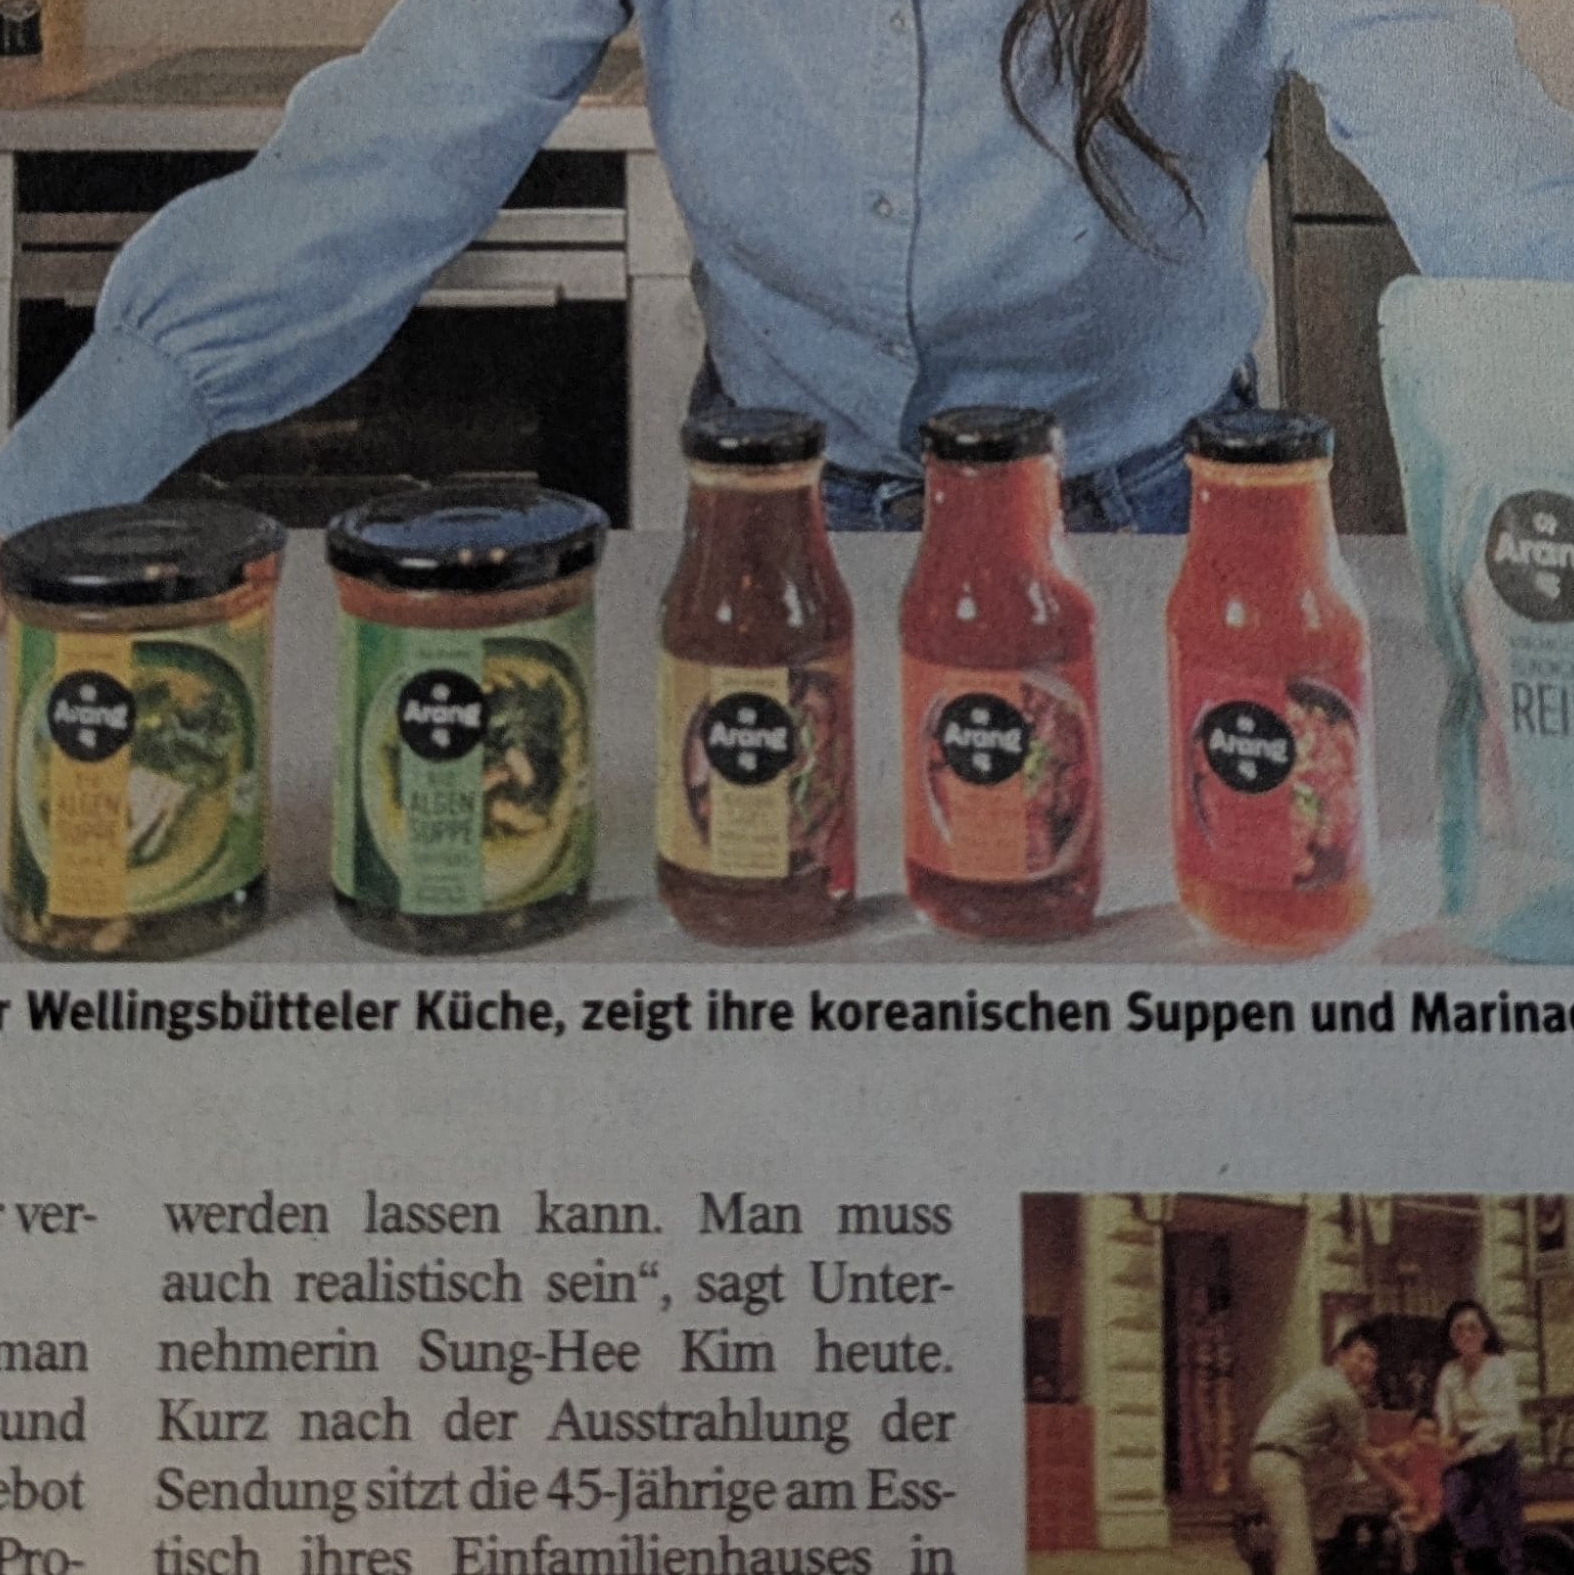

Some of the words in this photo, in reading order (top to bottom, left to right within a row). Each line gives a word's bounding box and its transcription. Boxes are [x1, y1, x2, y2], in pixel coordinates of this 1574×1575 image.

[402, 698, 482, 729] Arang
[708, 720, 789, 752] Arang
[944, 721, 1023, 754] Arang
[1209, 727, 1290, 764] Arang
[26, 988, 401, 1042] Wellingsbütteler
[415, 989, 566, 1038] Küche,
[581, 988, 692, 1042] zeigt
[707, 988, 795, 1033] ihre
[810, 988, 1111, 1033] koreanischen
[1126, 989, 1296, 1043] Suppen
[1310, 990, 1395, 1034] und
[14, 1202, 98, 1235] ver-
[157, 1397, 269, 1443] Kurz
[298, 1395, 412, 1443] nach
[443, 1396, 519, 1443] der
[546, 1396, 851, 1456] Ausstrahlung
[880, 1396, 957, 1444] der
